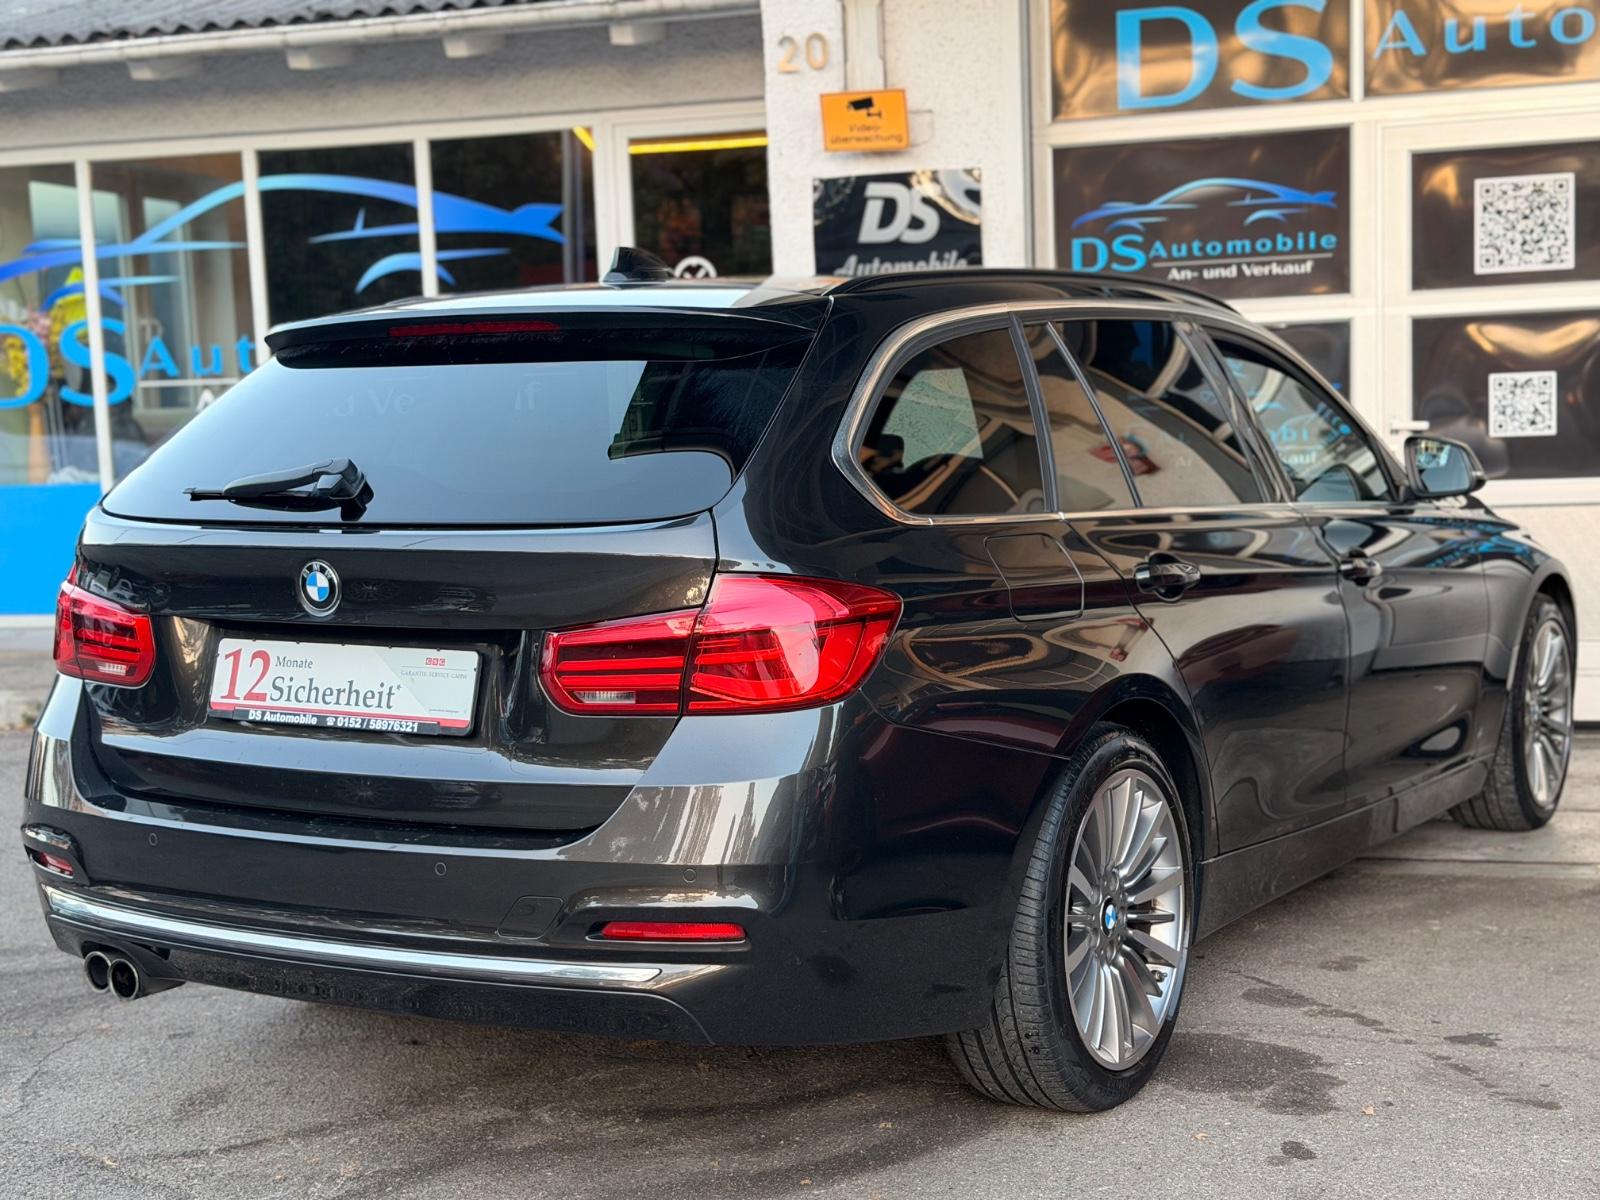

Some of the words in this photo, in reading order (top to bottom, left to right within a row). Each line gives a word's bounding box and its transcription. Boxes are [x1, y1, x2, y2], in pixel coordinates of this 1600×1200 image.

[778, 32, 829, 73] 20
[1115, 0, 1334, 110] DS
[1373, 4, 1597, 59] Auto
[857, 181, 941, 244] DS
[1071, 234, 1147, 272] DS
[1148, 230, 1338, 259] Automobile
[1167, 266, 1198, 281] An-
[1203, 263, 1238, 279] und
[1242, 260, 1315, 278] Verkauf
[220, 648, 271, 702] 12
[275, 656, 313, 669] Monate
[248, 710, 262, 720] DS
[263, 711, 318, 725] Automobile
[337, 717, 362, 729] 0152
[369, 719, 419, 732] 58976321
